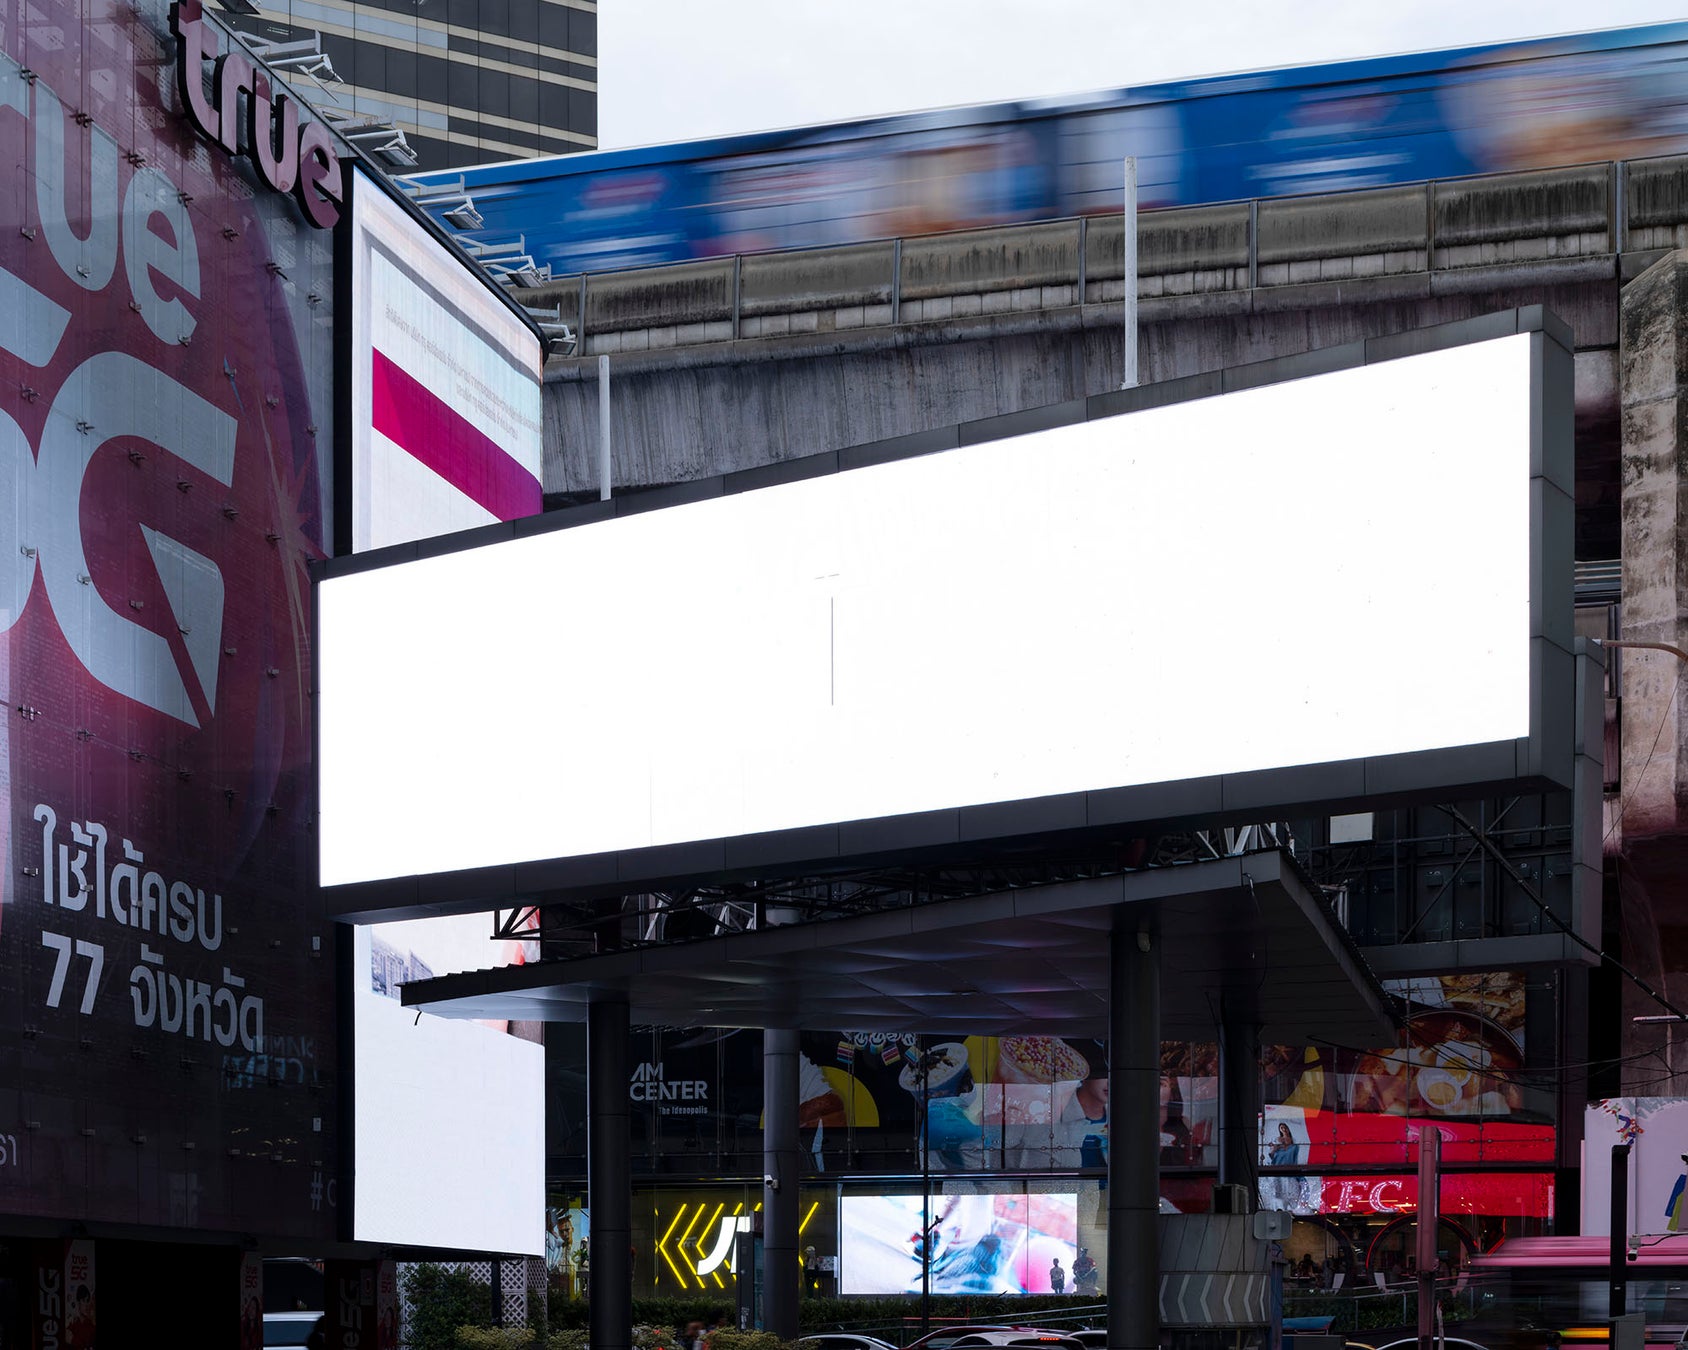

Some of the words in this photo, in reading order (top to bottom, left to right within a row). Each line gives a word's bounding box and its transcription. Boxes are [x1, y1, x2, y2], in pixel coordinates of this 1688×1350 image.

[170, 0, 343, 229] true
[33, 803, 223, 951] ใช้ได้ครบ
[42, 931, 104, 1015] 77
[130, 943, 264, 1054] จังหวัด
[629, 1080, 709, 1101] CENTER
[71, 1266, 88, 1281] 5G
